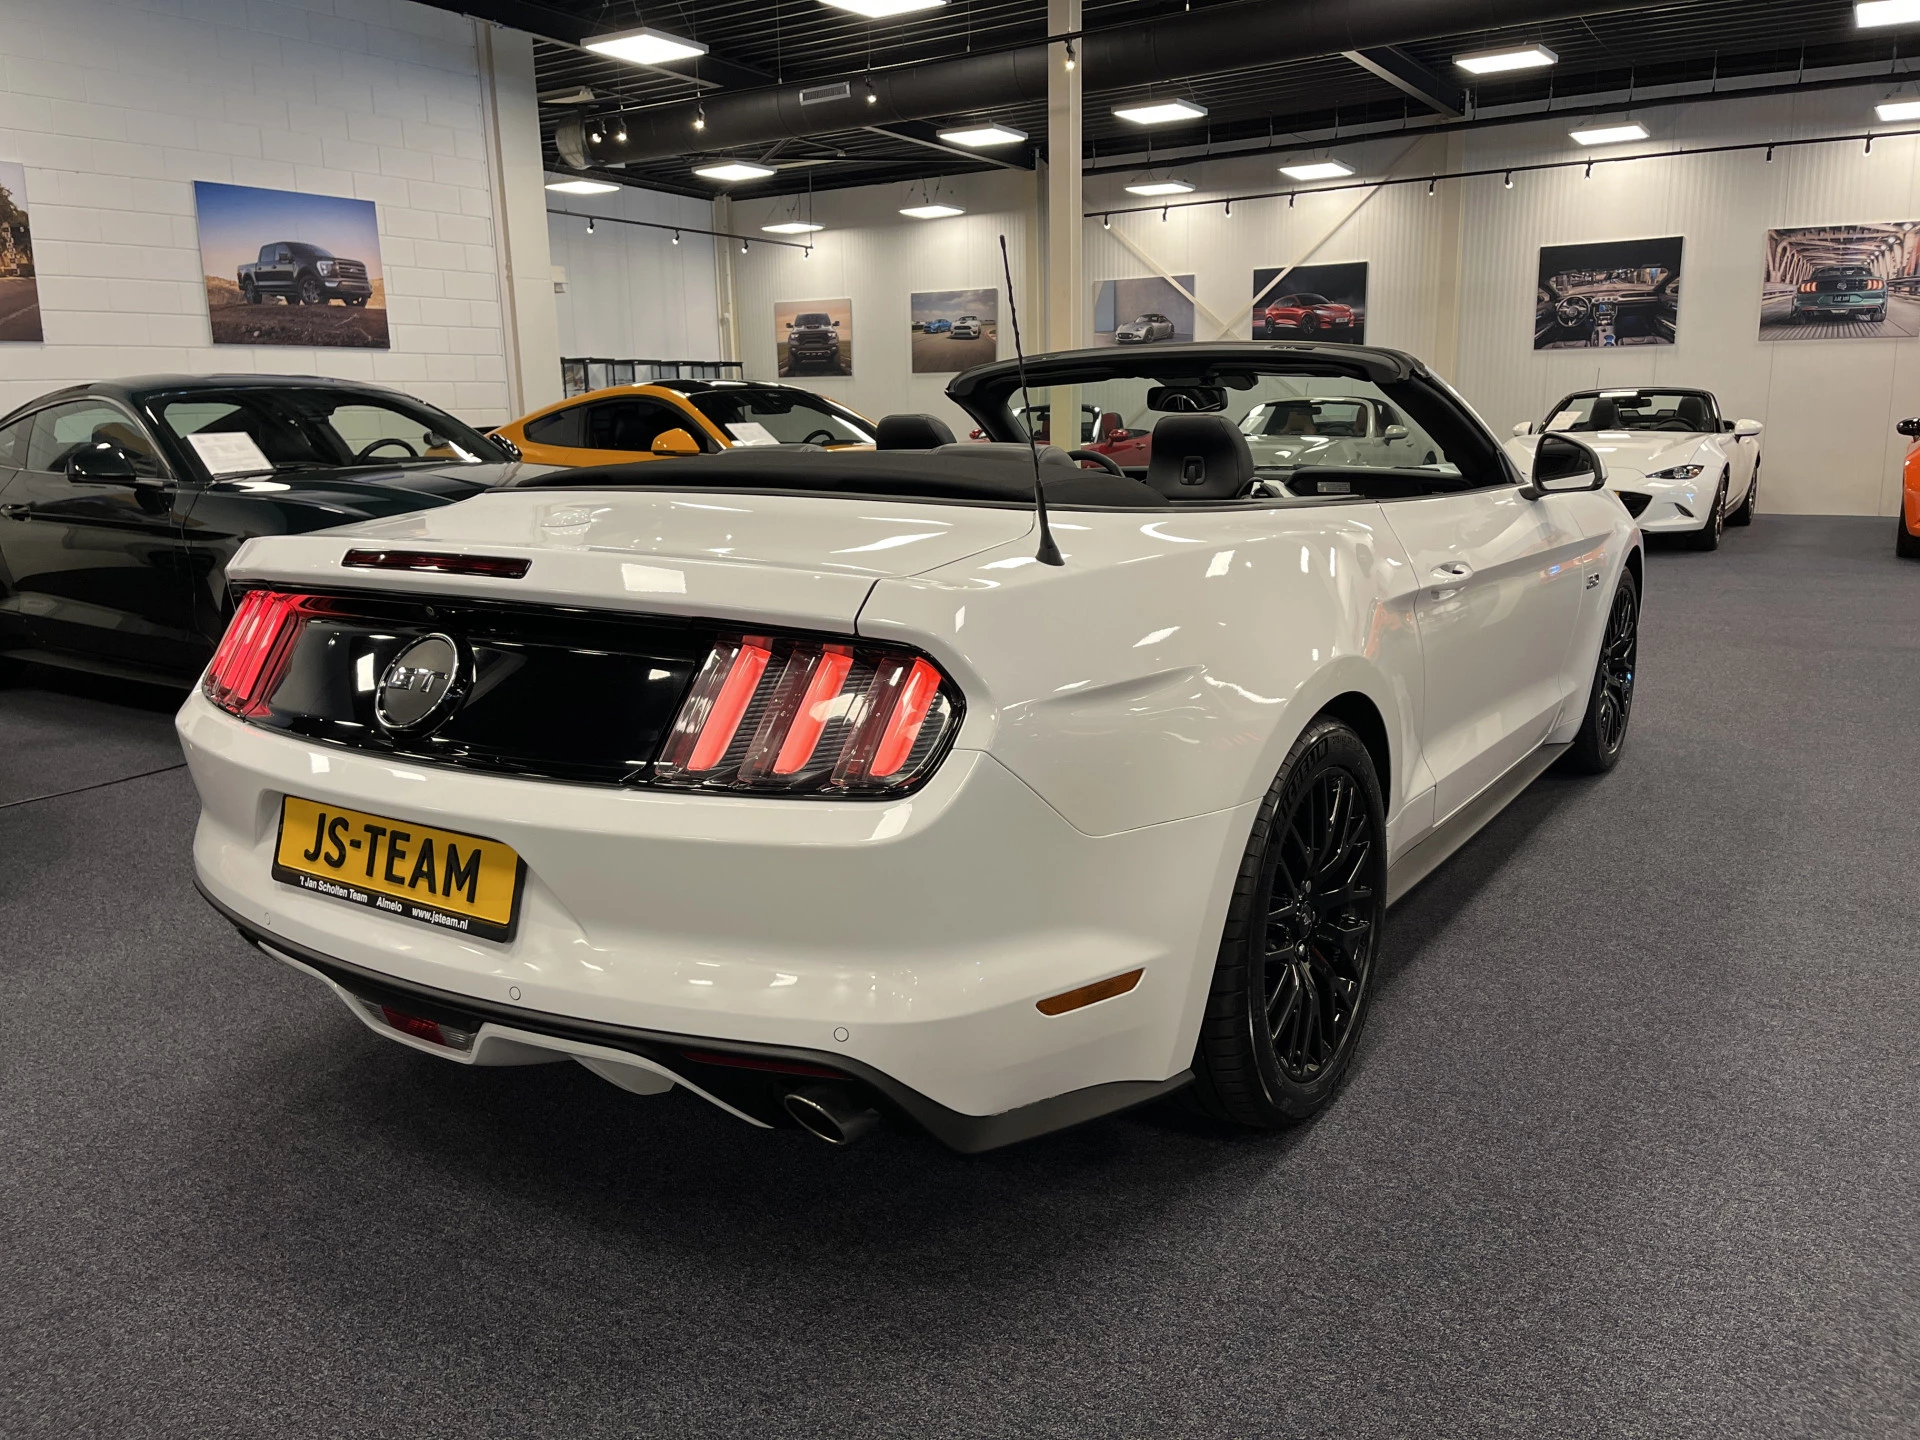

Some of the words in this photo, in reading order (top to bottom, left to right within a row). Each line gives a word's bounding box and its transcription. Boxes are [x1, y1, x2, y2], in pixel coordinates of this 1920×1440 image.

[304, 813, 482, 904] JS-TEAM
[305, 877, 318, 889] Jan
[318, 880, 348, 898] Scholten
[349, 888, 368, 903] Team
[376, 896, 403, 912] Almelo
[412, 907, 469, 930] www.jsteam.nl
